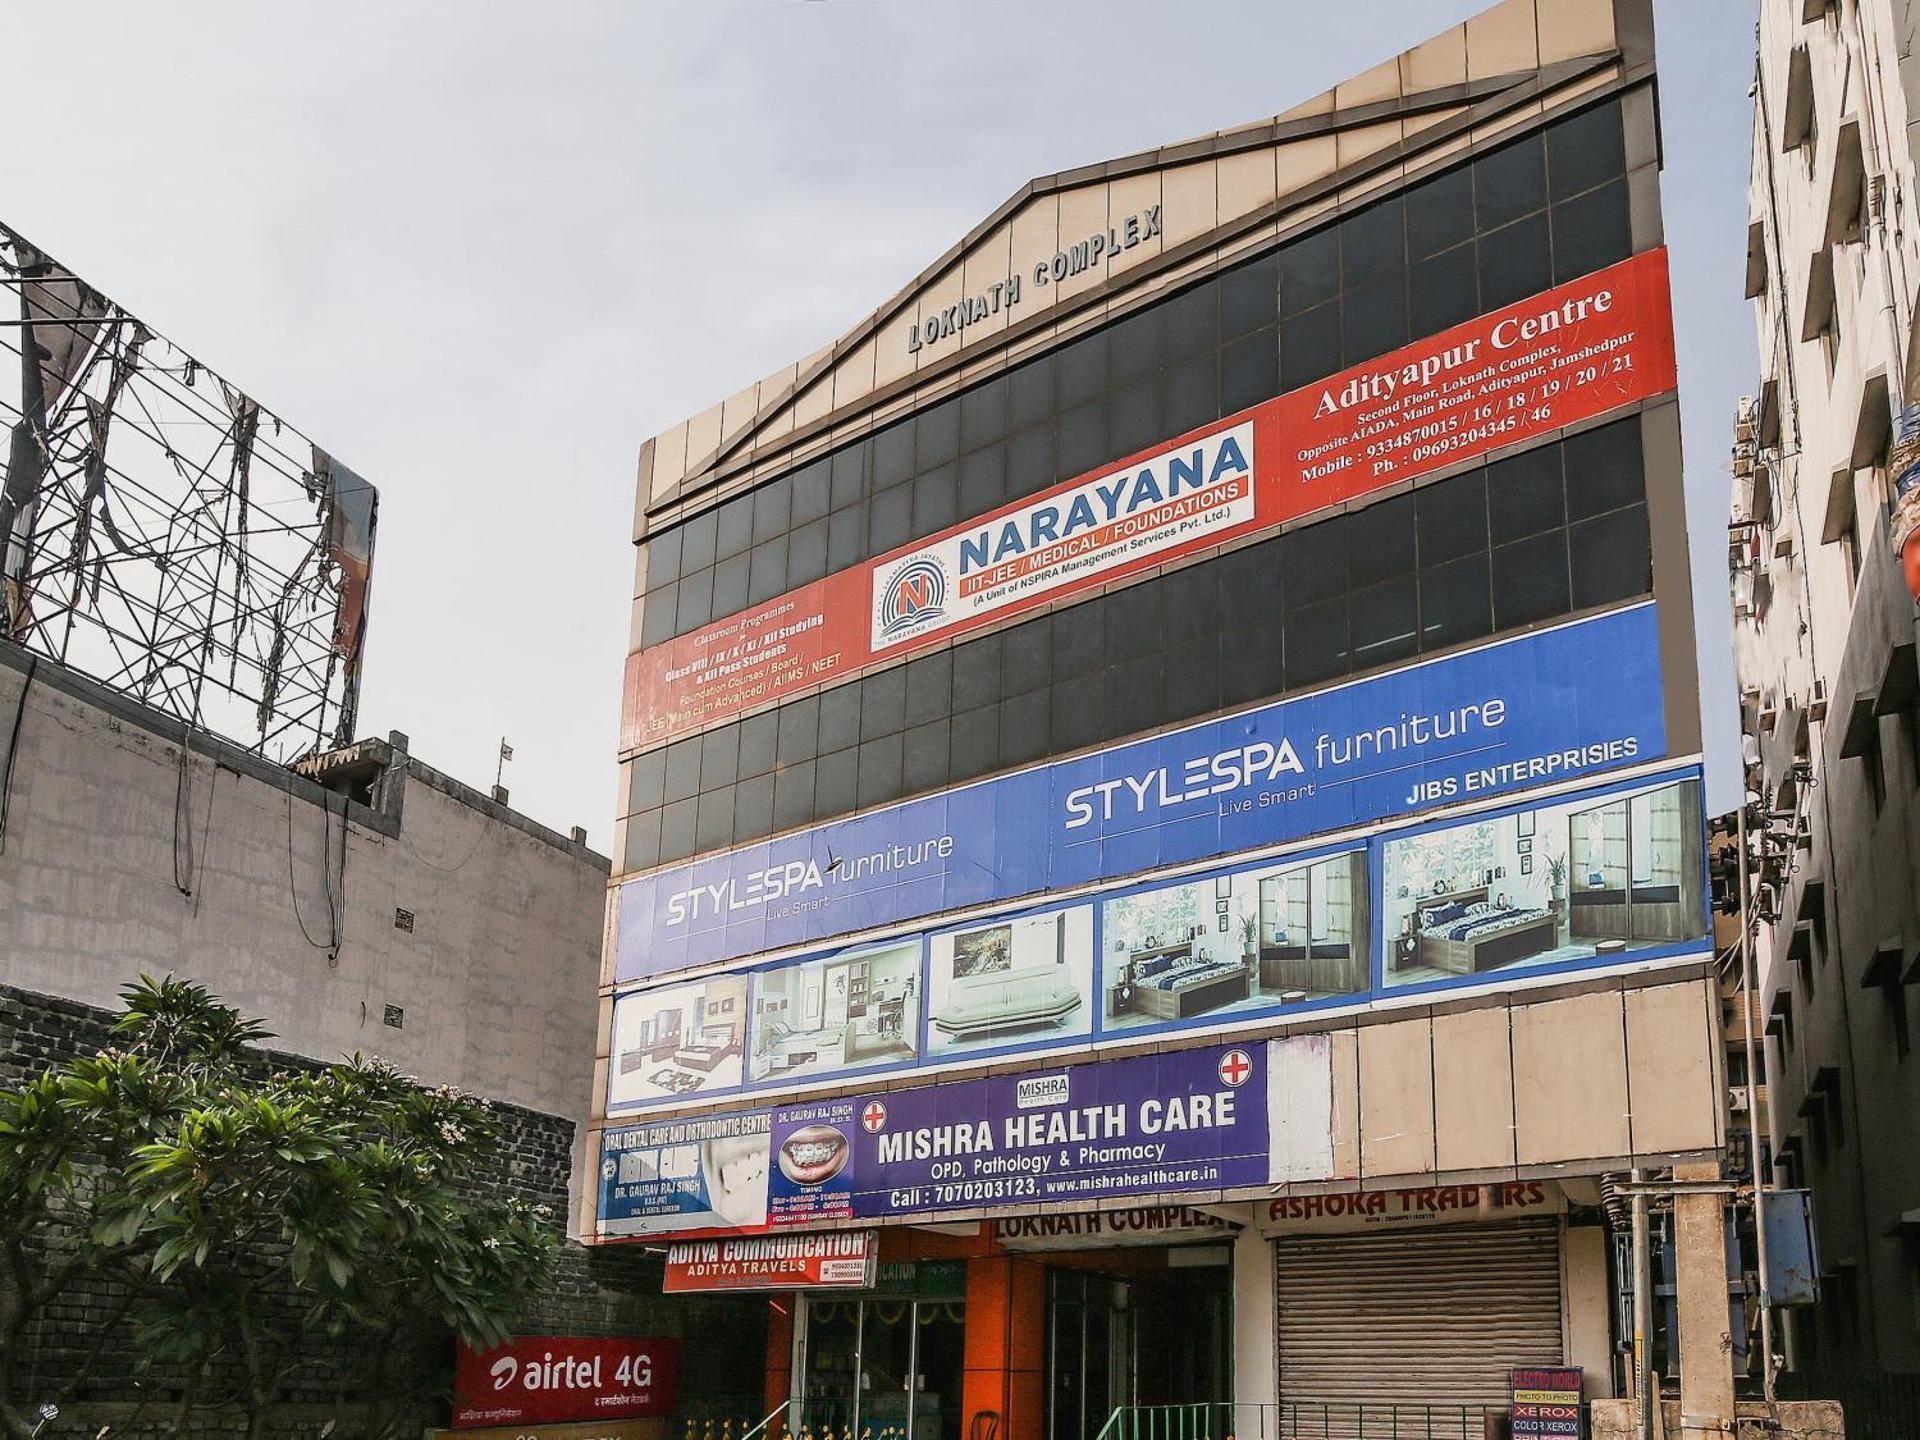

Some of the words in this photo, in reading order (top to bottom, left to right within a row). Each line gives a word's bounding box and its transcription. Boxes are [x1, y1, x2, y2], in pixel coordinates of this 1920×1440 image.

[908, 274, 1021, 353] LOKNATH
[1033, 204, 1161, 287] COMPLEX
[1314, 335, 1481, 419] Adityapur
[1491, 288, 1613, 349] Centre
[1297, 437, 1348, 462] Opposite
[1350, 420, 1399, 442] AIADA,
[1402, 405, 1436, 422] Main
[1438, 391, 1475, 413] Road,
[1479, 366, 1547, 397] Adityapur,
[1550, 331, 1635, 374] Jamshedpur
[1357, 401, 1400, 424] Second
[1403, 387, 1439, 411] Floor,
[1442, 367, 1496, 396] Loknath
[1499, 345, 1561, 376] Complex,
[1301, 456, 1353, 484] Mobile
[1366, 415, 1458, 458] 9334870015
[1473, 404, 1492, 422] 16
[1507, 392, 1526, 410] 18
[1541, 380, 1560, 398] 19
[1576, 367, 1596, 386] 20
[1612, 354, 1634, 374] 21
[1373, 457, 1398, 477] Ph.
[1412, 415, 1516, 462] 09693204345
[1531, 404, 1551, 422] 46
[959, 436, 1248, 575] NARAYANA
[966, 562, 1017, 591] IIT-JEE
[1030, 536, 1100, 572] MEDICAL
[1114, 481, 1239, 537] FOUNDATIONS
[973, 591, 984, 608] (A
[986, 586, 1006, 603] Unit
[1008, 581, 1019, 595] of
[1020, 567, 1060, 590] NSPIRA
[1061, 546, 1128, 577] Management
[1130, 528, 1177, 549] Services
[1180, 518, 1202, 533] Pvt.
[1205, 507, 1231, 525] Ltd.)
[899, 574, 927, 615] N
[694, 624, 738, 648] Classroom
[740, 601, 795, 630] Programmes
[888, 625, 926, 642] NARAYANA
[665, 666, 690, 682] Class
[715, 652, 726, 664] IX
[779, 614, 824, 640] Studying
[719, 661, 741, 679] Pass
[743, 643, 787, 669] Students
[679, 681, 727, 706] Foundation
[728, 670, 764, 689] Courses
[771, 654, 798, 674] Board
[715, 681, 766, 709] Advanced)
[773, 668, 804, 688] AIIMS
[811, 653, 841, 673] NEET
[1065, 737, 1305, 829] STYLESPA
[1315, 698, 1506, 769] furniture
[1405, 776, 1458, 805] JIBS
[1465, 736, 1638, 793] ENTERPRISIES
[1218, 799, 1252, 817] Live
[1258, 782, 1316, 809] Smart
[666, 857, 823, 926] STYLESPA
[828, 835, 953, 885] furniture
[766, 904, 789, 921] Live
[792, 896, 831, 916] Smart
[1019, 1078, 1067, 1097] MISHRA
[817, 1106, 830, 1119] RAJ
[831, 1104, 853, 1117] SINGH
[878, 1120, 994, 1166] MISHRA
[1005, 1104, 1126, 1149] HEALTH
[1140, 1091, 1236, 1136] CARE
[605, 1133, 623, 1152] ORAL
[623, 1130, 649, 1150] DENTAL
[649, 1127, 669, 1147] CARE
[669, 1124, 685, 1143] AND
[686, 1118, 741, 1142] ORTHODONTIC
[741, 1114, 771, 1135] CENTRE
[931, 1161, 966, 1180] OPD,
[974, 1154, 1051, 1176] Pathology
[1060, 1150, 1070, 1166] &
[1079, 1141, 1166, 1168] Pharmacy
[615, 1187, 627, 1199] DR.
[629, 1183, 660, 1197] GAURAV
[661, 1181, 676, 1195] RAJ
[676, 1178, 701, 1194] SINGH
[890, 1189, 920, 1208] Call
[935, 1179, 1041, 1204] 7070203123,
[1047, 1166, 1217, 1193] www.mishrahealthcare.in
[1269, 1190, 1386, 1222] ASHOKA
[1396, 1182, 1545, 1212] TRADRS
[995, 1210, 1101, 1238] LOKNATH
[667, 1243, 719, 1265] ADITYA
[723, 1231, 865, 1262] COMMUNICATION
[687, 1262, 737, 1276] ADITYA
[742, 1260, 807, 1274] TRAVELS
[523, 1352, 602, 1390] airtel
[615, 1355, 652, 1387] 4G
[1514, 1420, 1544, 1431] COLOR
[1546, 1421, 1577, 1432] XEROX
[1516, 1406, 1577, 1418] XEROX
